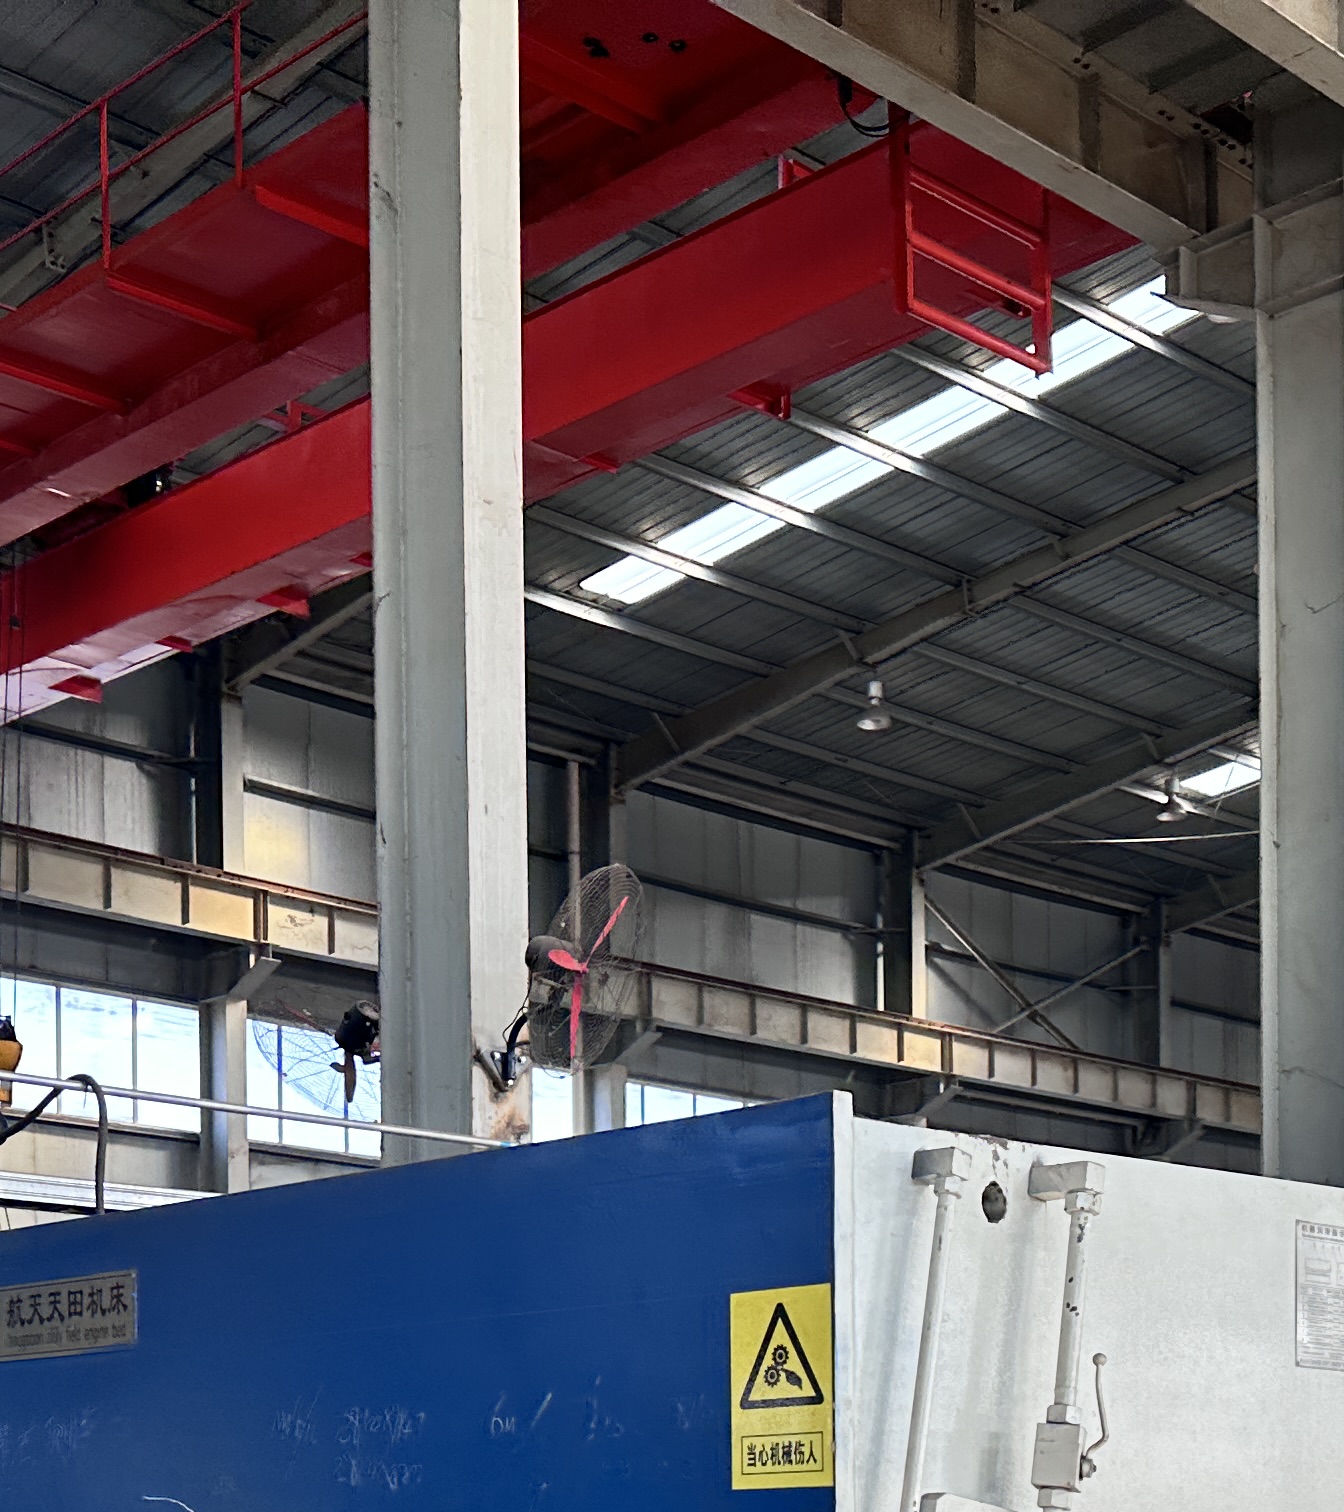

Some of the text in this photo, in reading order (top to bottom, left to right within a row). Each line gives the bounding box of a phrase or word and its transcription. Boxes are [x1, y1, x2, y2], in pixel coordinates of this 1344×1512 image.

[746, 1442, 818, 1468] 当心机械伤人
